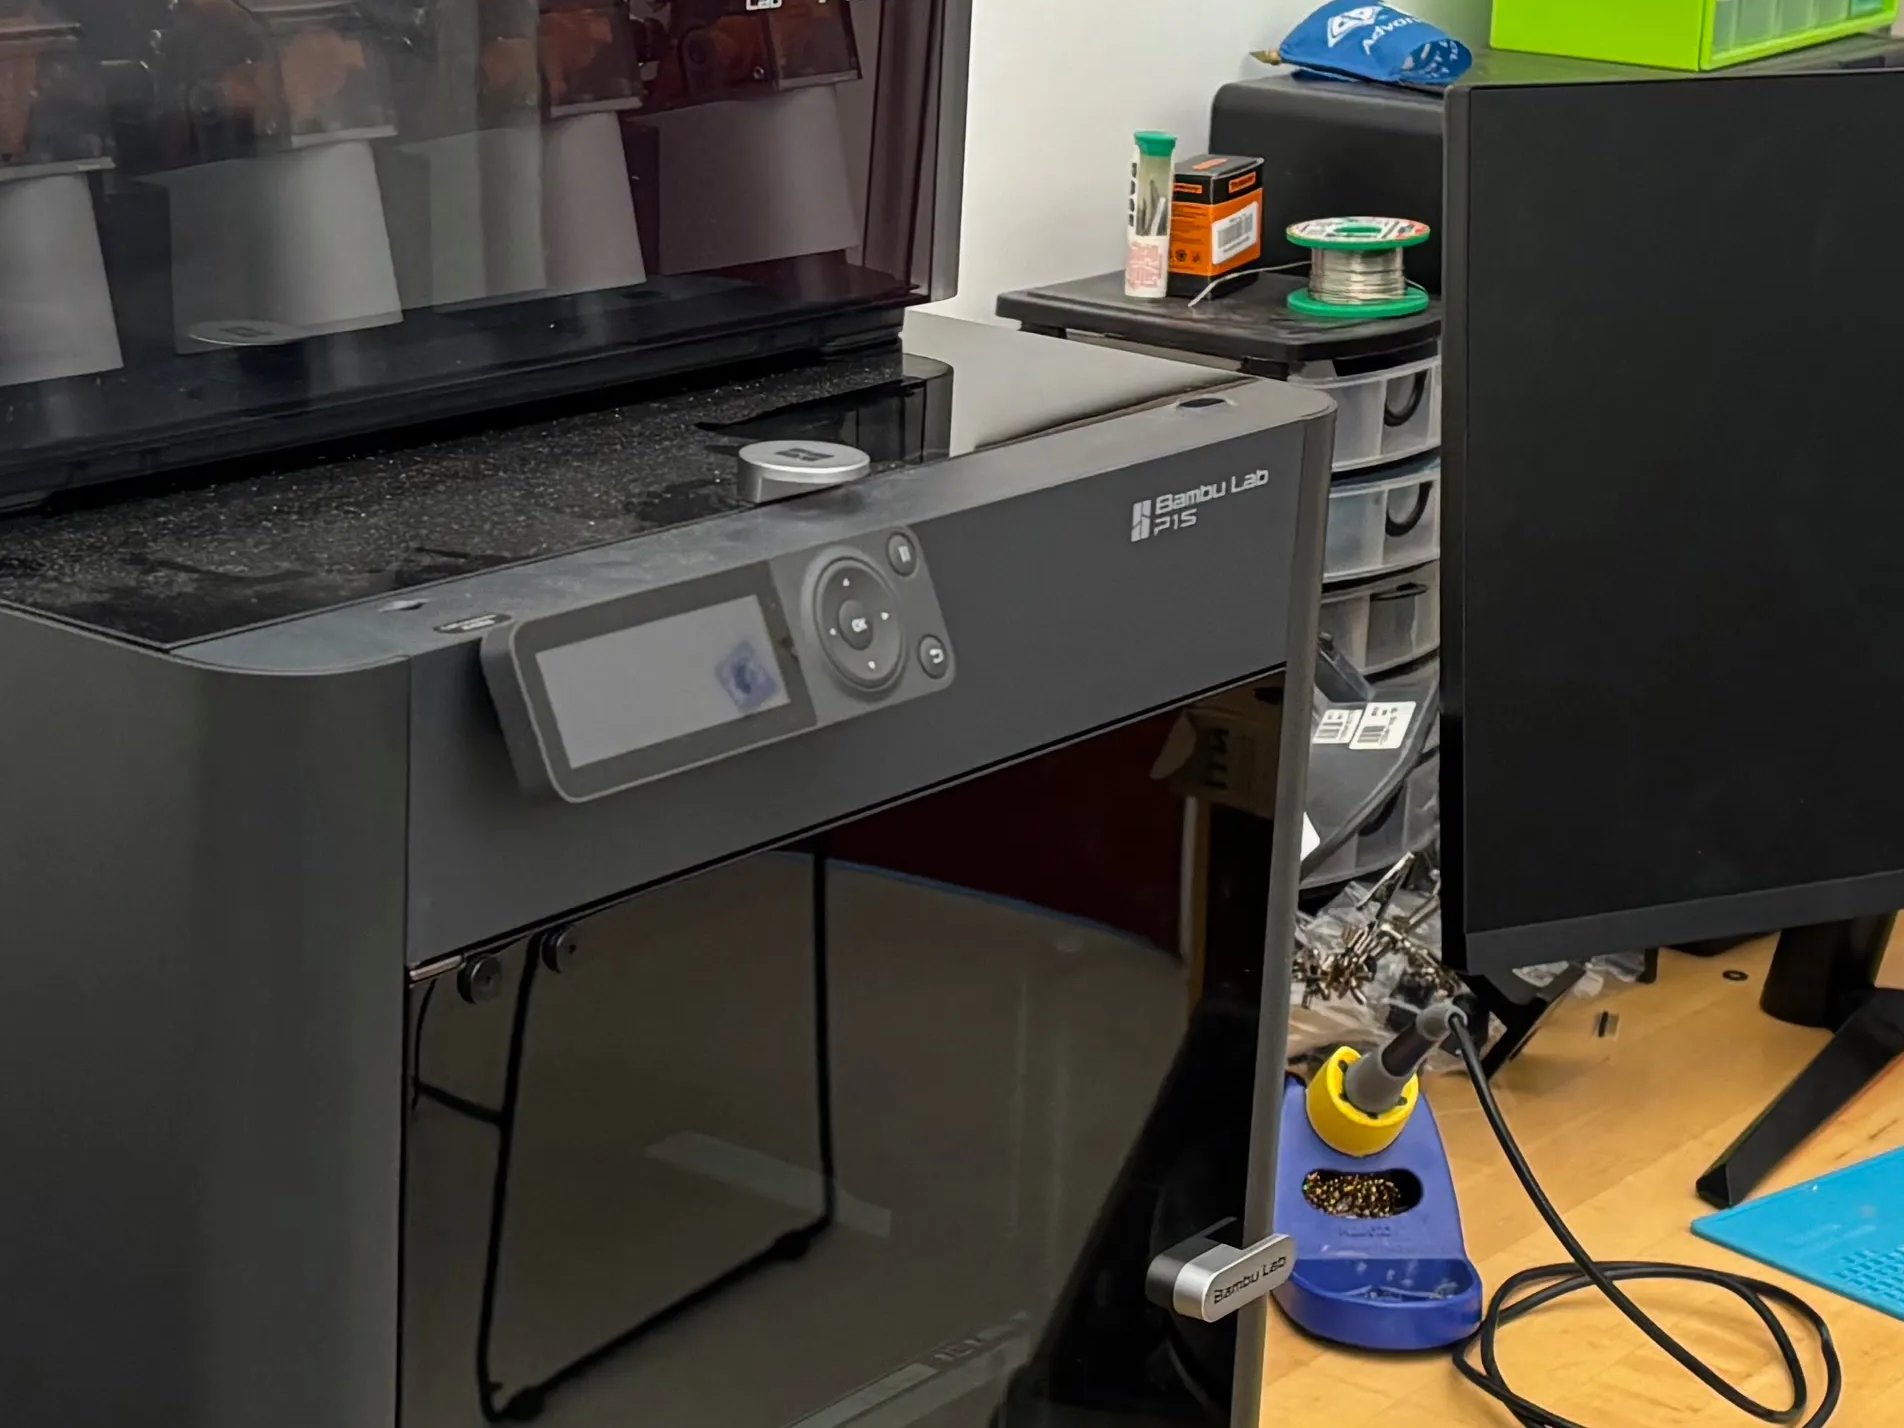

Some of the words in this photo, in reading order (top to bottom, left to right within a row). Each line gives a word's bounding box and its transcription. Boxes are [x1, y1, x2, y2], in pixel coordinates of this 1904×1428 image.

[1155, 480, 1228, 515] Bambu
[1230, 468, 1270, 495] Lab
[1153, 507, 1198, 537] P1S
[1213, 1270, 1260, 1305] Bambu
[1262, 1256, 1287, 1278] Lab
